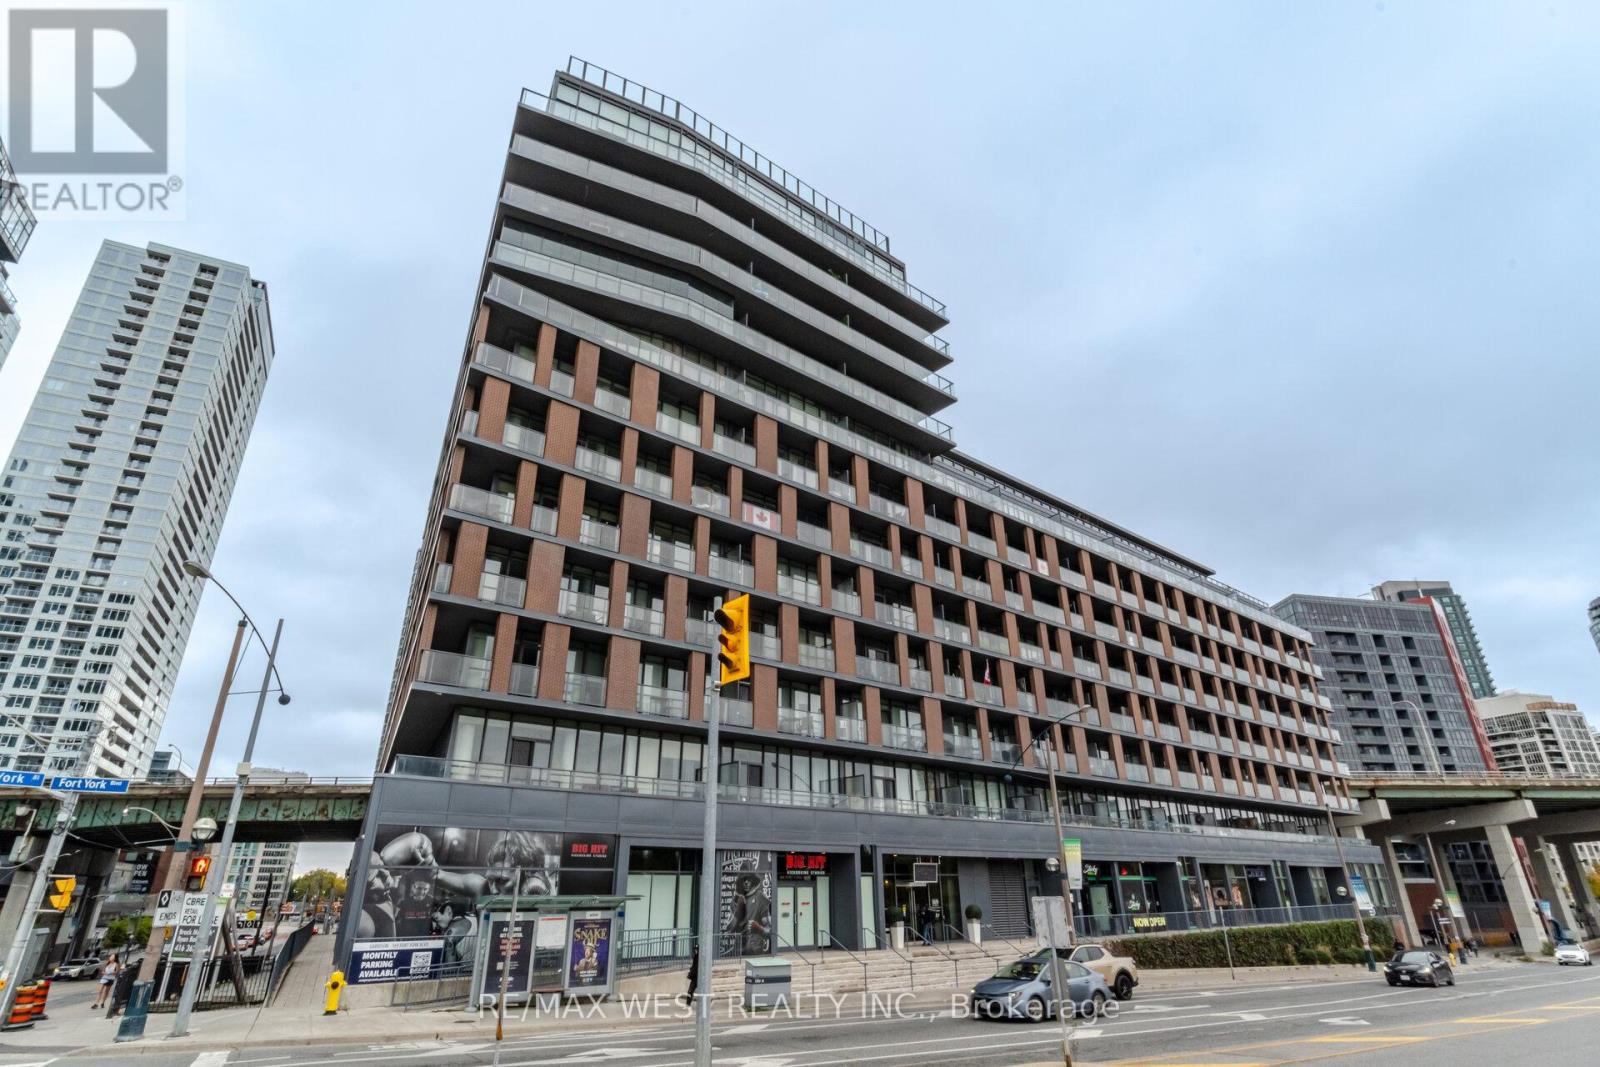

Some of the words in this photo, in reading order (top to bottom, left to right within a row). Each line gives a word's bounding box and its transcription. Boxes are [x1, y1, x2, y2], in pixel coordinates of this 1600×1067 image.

[59, 778, 81, 788] Fort
[85, 779, 107, 789] York
[571, 843, 589, 853] BIG
[591, 843, 608, 854] HIT
[786, 855, 805, 869] BIG
[807, 855, 826, 869] HIT
[186, 897, 206, 906] CBRE
[159, 911, 177, 921] ENDS
[182, 915, 197, 924] FOR
[1133, 917, 1150, 927] NOW
[1149, 916, 1166, 927] OPEN
[574, 927, 608, 941] SNAKE
[362, 951, 399, 960] MONTHLY
[360, 960, 394, 969] PARKING
